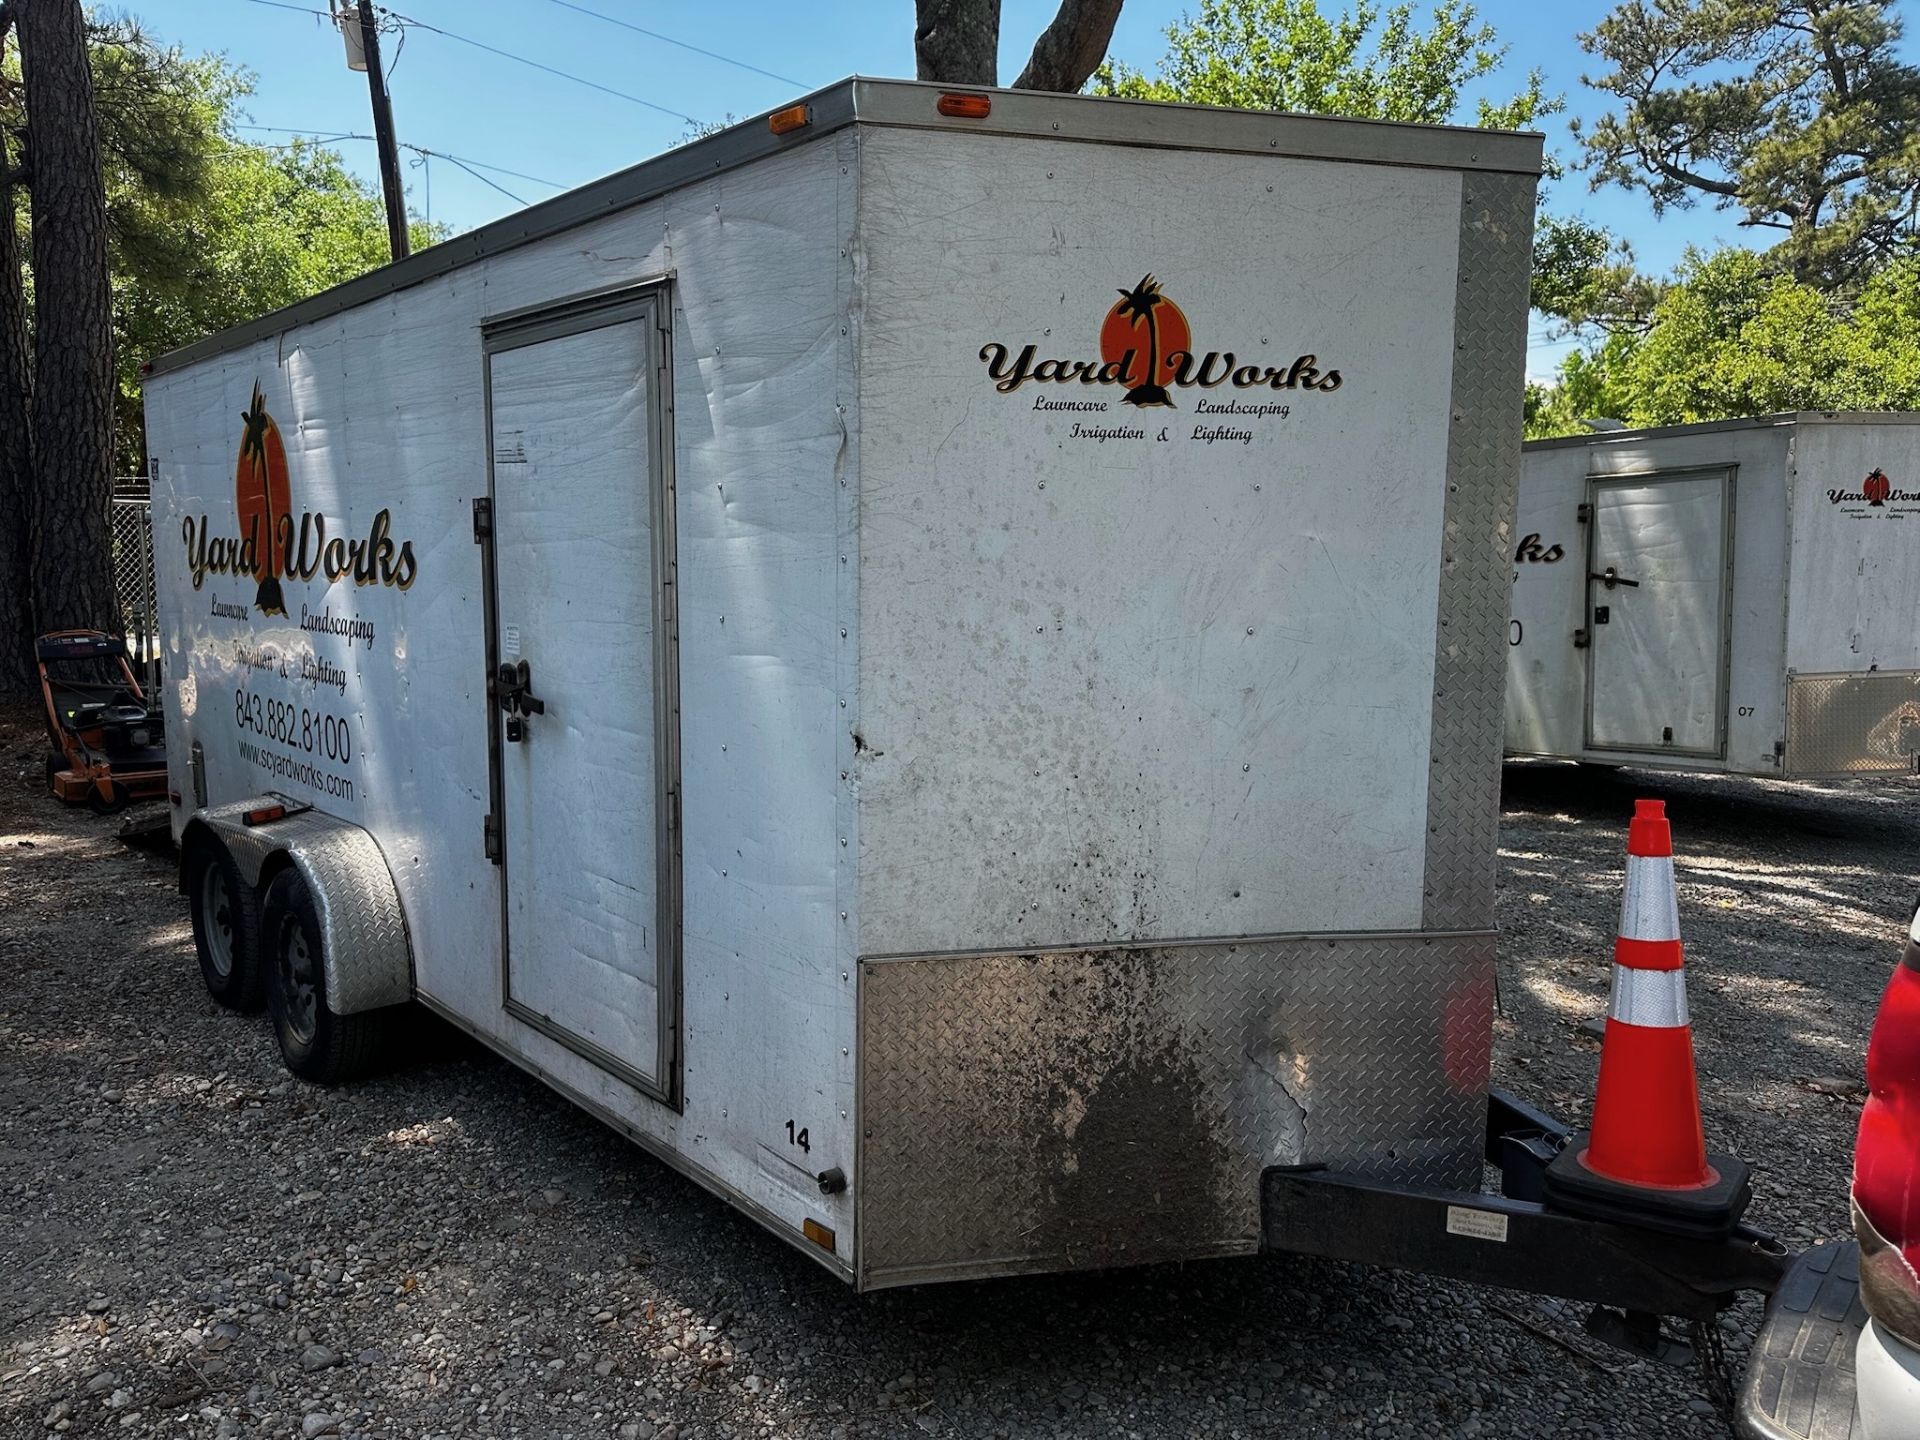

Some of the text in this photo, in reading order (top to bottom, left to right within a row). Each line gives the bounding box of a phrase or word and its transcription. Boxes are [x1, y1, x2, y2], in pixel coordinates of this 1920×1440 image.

[979, 343, 1343, 394] Yard Works
[1032, 395, 1290, 419] Lawncare Landscaping
[1069, 423, 1254, 444] Irrigation & Lighting
[183, 508, 417, 591] Yard Works
[210, 593, 375, 650] Lawncare Landscaping
[301, 650, 347, 696] Lighting
[235, 688, 351, 764] 843.882.8100
[1738, 706, 1755, 717] 07
[238, 740, 354, 801] www.scyardworks.com
[785, 1119, 811, 1154] 14
